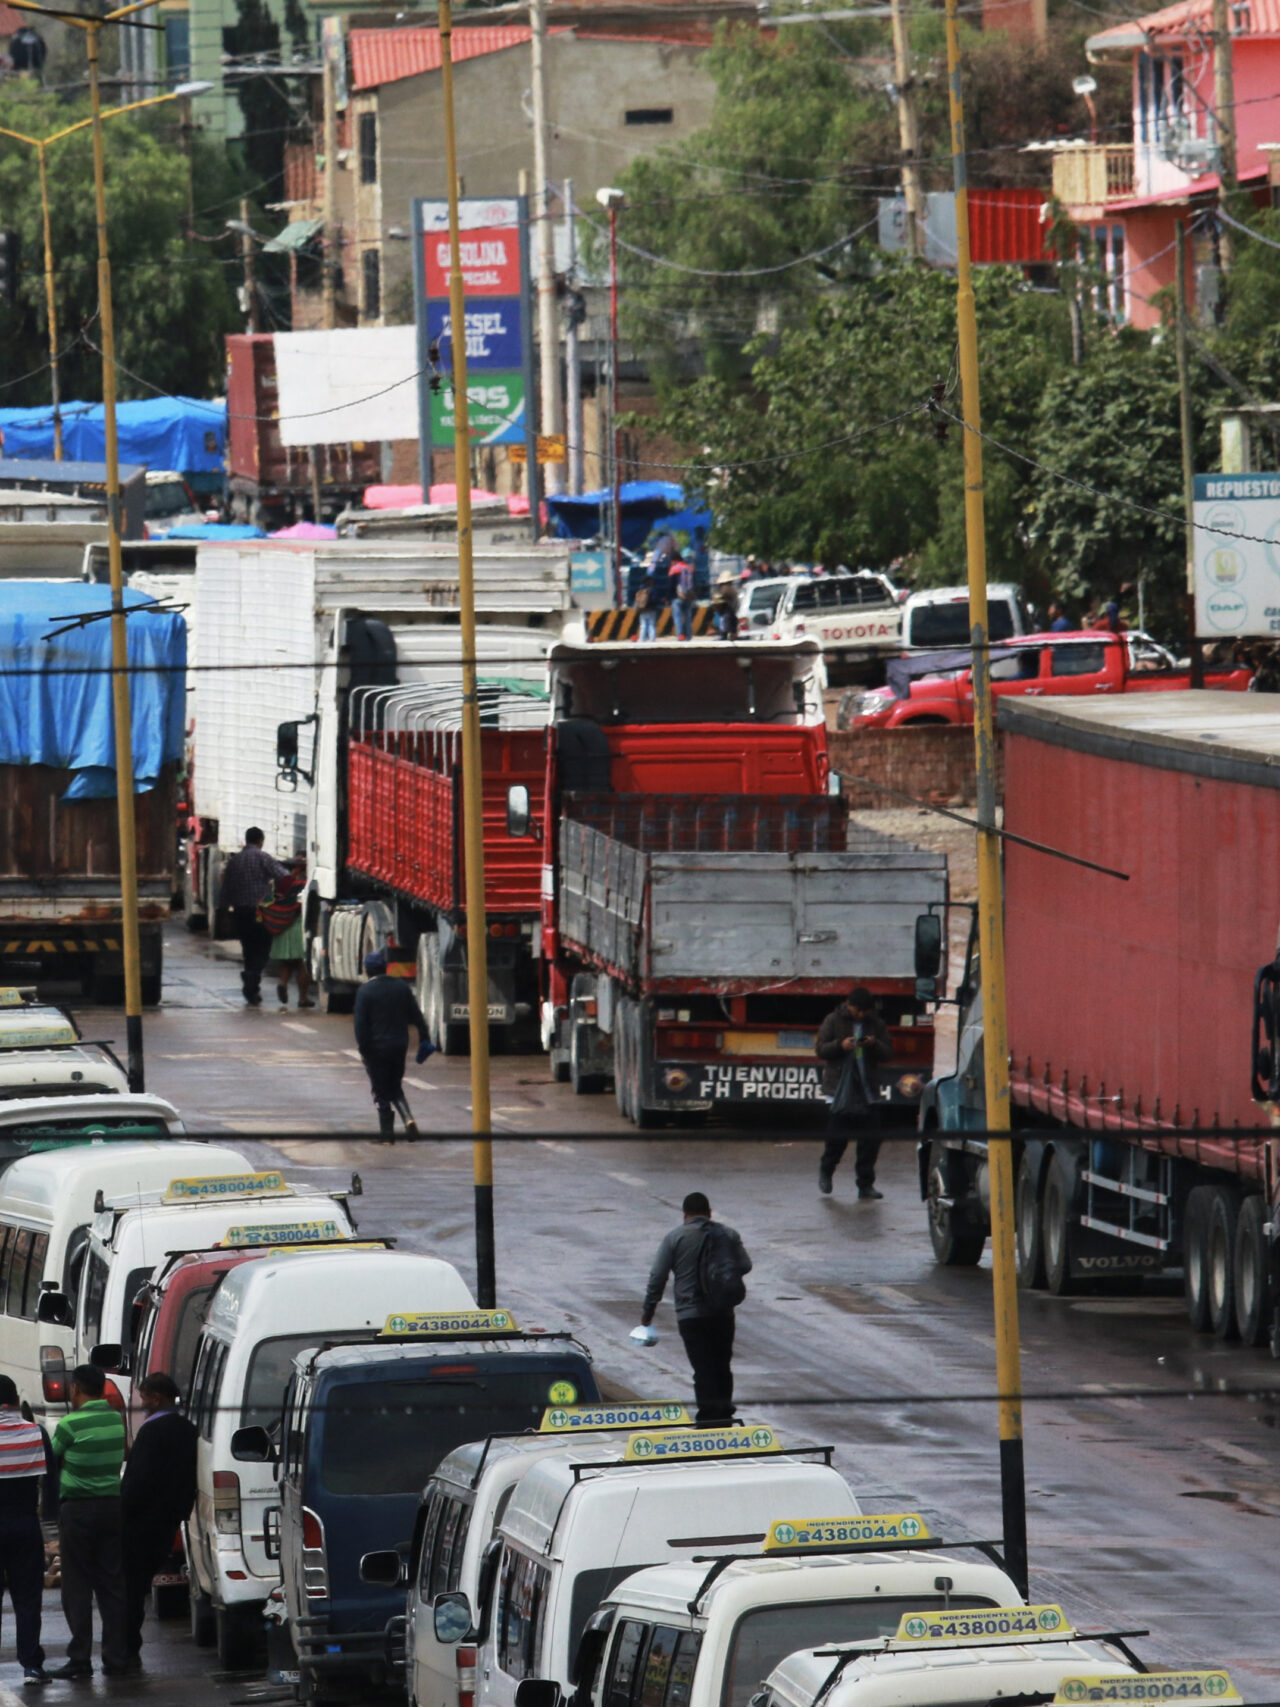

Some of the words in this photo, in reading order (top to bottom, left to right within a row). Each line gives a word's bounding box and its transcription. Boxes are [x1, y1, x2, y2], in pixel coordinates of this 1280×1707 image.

[1206, 481, 1280, 498] REPUESTO
[1210, 603, 1245, 613] DAF
[822, 623, 889, 640] TOYOTA
[705, 1065, 732, 1081] TU
[736, 1066, 819, 1083] ENVIDIA
[700, 1081, 730, 1098] FH
[200, 1181, 265, 1194] 4380044
[262, 1229, 320, 1242] 4380044
[1078, 1256, 1155, 1268] VOLVO
[419, 1319, 491, 1332] 4380044
[582, 1410, 662, 1425] 4380044
[669, 1437, 751, 1453] 4380044
[806, 1519, 872, 1527] INDEPENDIENTE
[812, 1525, 898, 1542] 4380044
[939, 1612, 1009, 1621] INDEPENDIENTE
[945, 1617, 1038, 1636] 4380044
[1100, 1676, 1173, 1685] INDEPENDIENTE
[1105, 1682, 1204, 1700] 4380044
